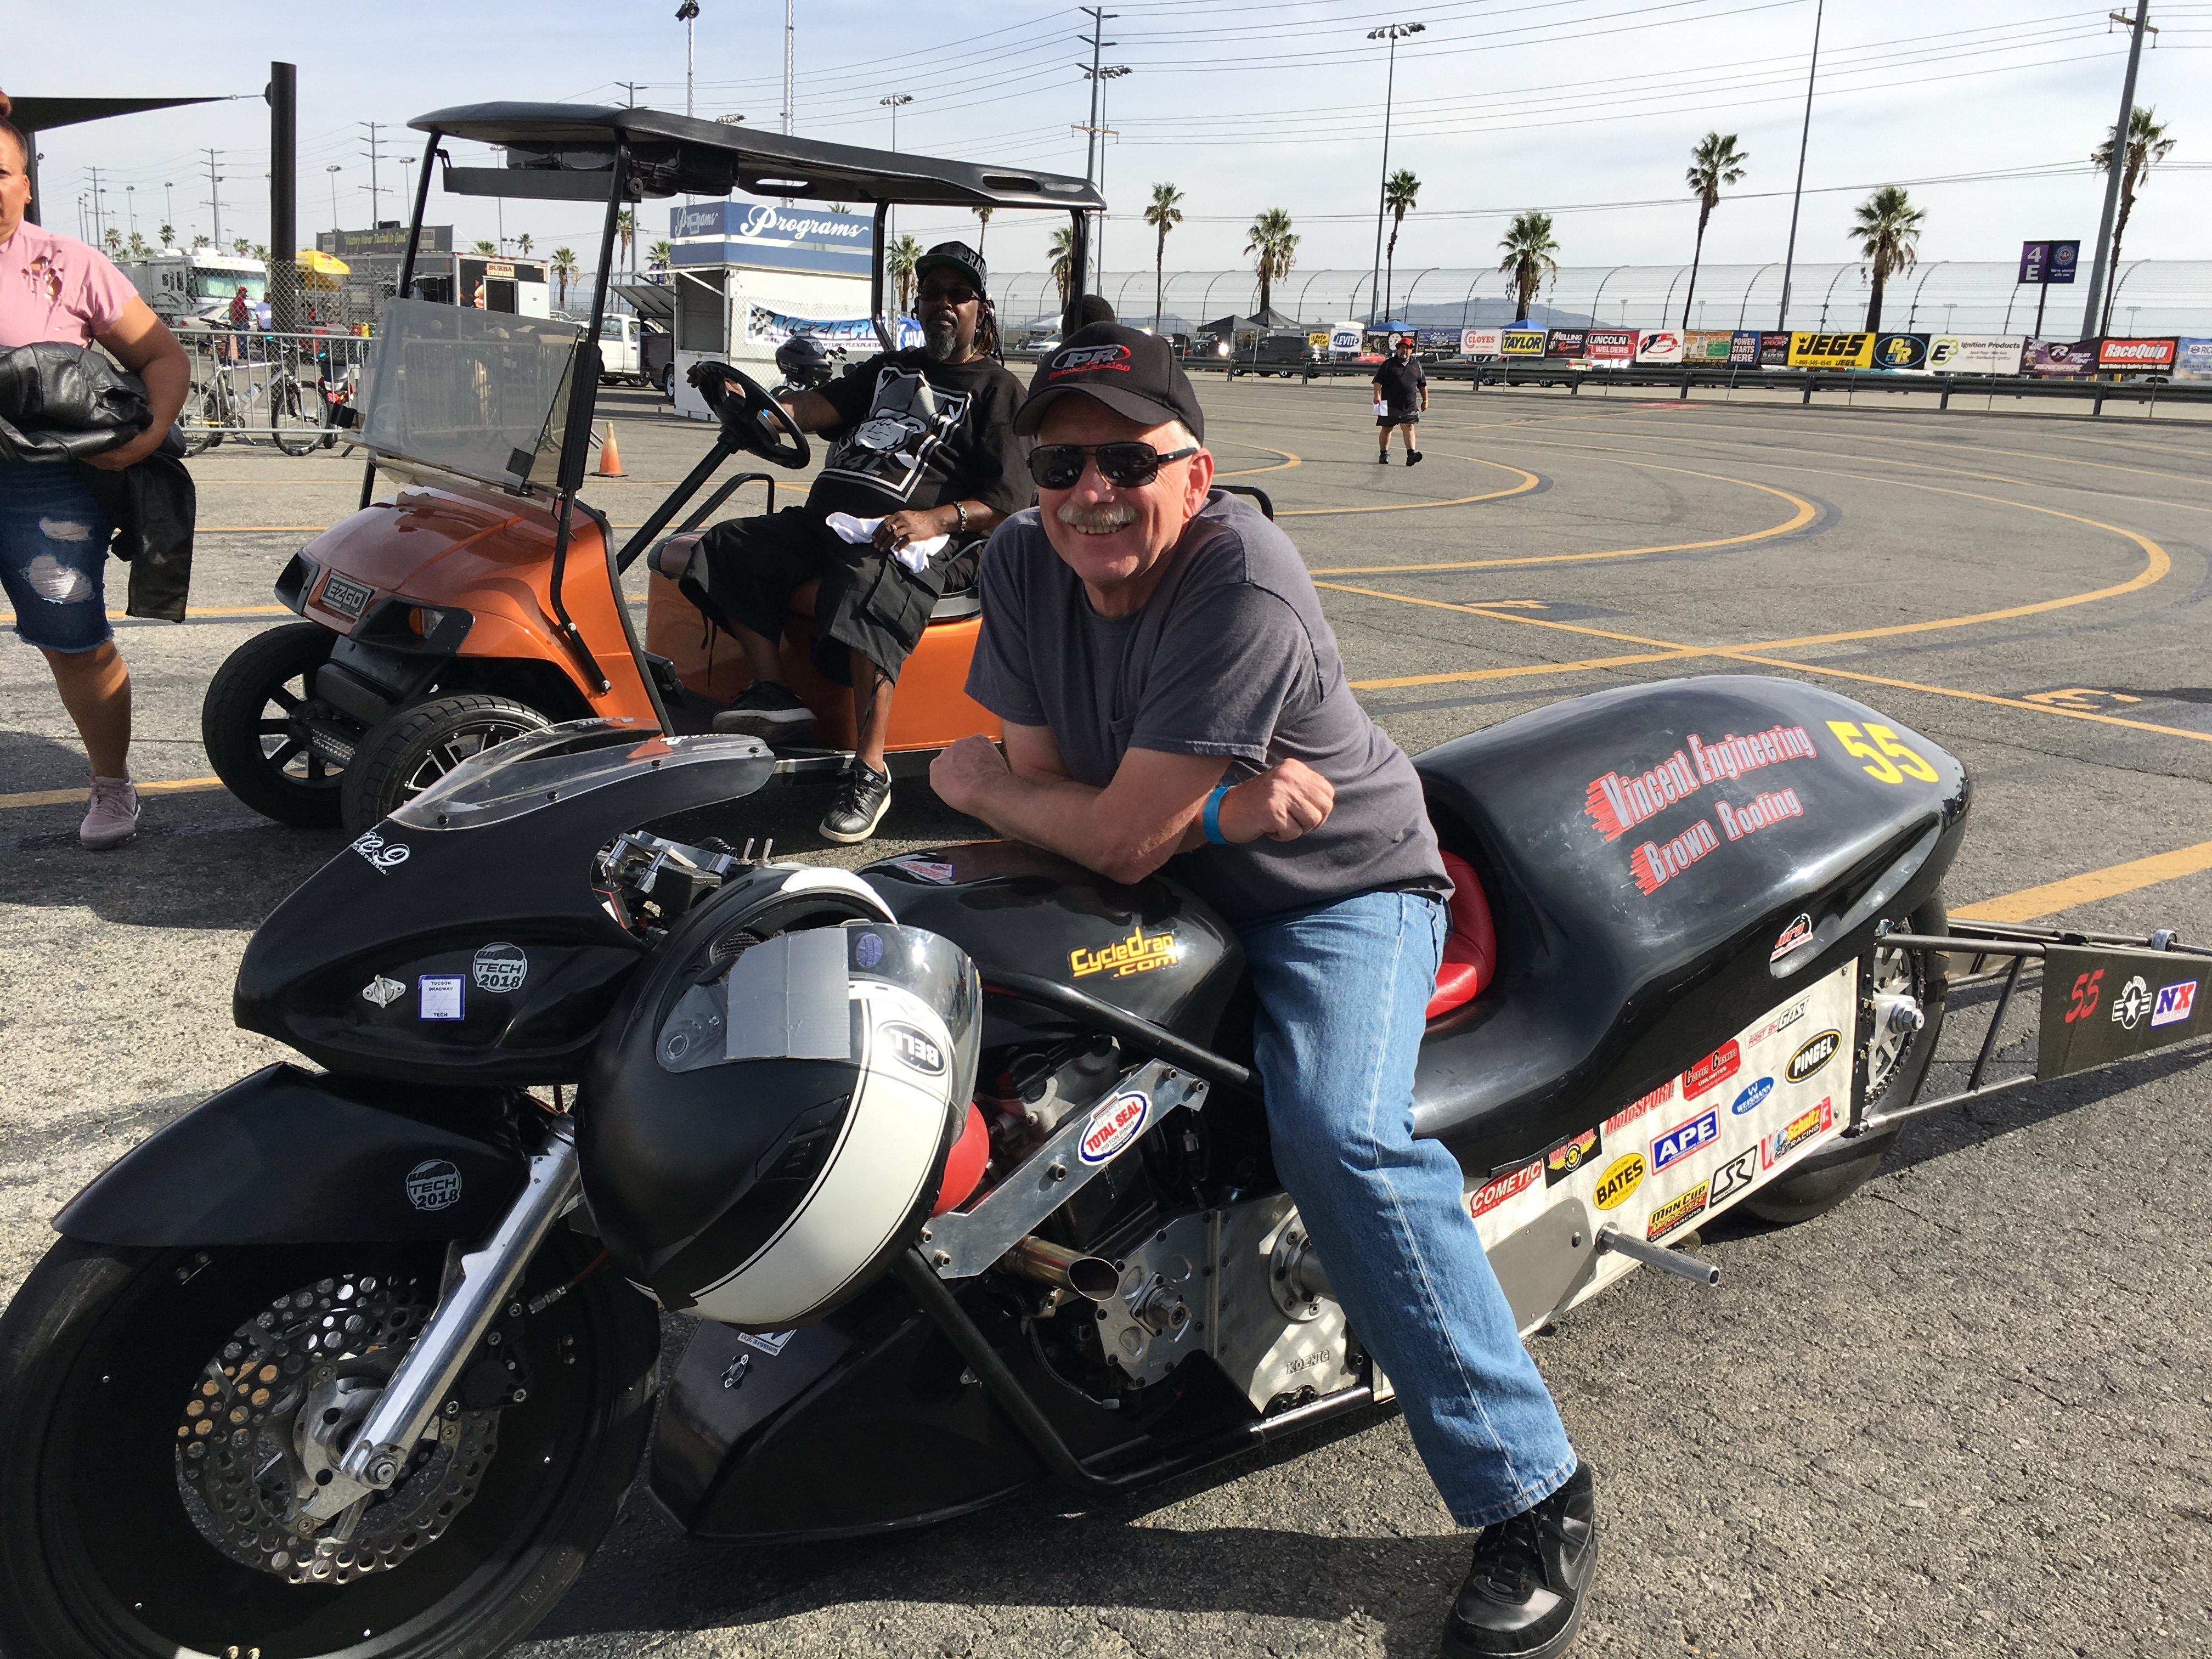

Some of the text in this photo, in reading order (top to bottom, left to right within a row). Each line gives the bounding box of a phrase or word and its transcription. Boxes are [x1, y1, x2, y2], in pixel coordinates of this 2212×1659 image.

[741, 205, 869, 240] Programs
[2027, 247, 2041, 262] 4
[2025, 264, 2040, 280] E
[771, 314, 878, 341] MEZIER
[1331, 334, 1359, 346] CLEVITE
[1552, 331, 1583, 341] MELLING
[1590, 336, 1627, 345] LINCOLN
[1503, 336, 1543, 349] TAYLOR
[1595, 346, 1629, 354] WELDERS
[1796, 334, 1868, 356] JEGS
[2104, 343, 2168, 359] RaceQuip
[1730, 353, 1753, 362] HERE
[328, 582, 364, 608] EZGO
[1825, 720, 1940, 784] 55
[1599, 725, 1817, 831] Vincent Engineering
[1643, 787, 1805, 885] Brown Roofing
[476, 962, 522, 974] TECH
[1113, 955, 1177, 978] .com
[478, 974, 521, 988] 2018
[2064, 969, 2104, 1024] 55
[2156, 983, 2195, 1015] NX
[889, 1028, 939, 1069] BELL
[1794, 1036, 1833, 1076] PINGEL
[1698, 1066, 1727, 1086] UNLIMITED
[1737, 1084, 1770, 1113] WEISMANN
[1086, 1101, 1141, 1152] TOTAL SEAL
[1101, 1120, 1135, 1152] PISTON RINGS
[1788, 1109, 1820, 1141] Schnitz
[1791, 1124, 1819, 1147] RACING
[1658, 1116, 1714, 1163] APE
[1606, 1159, 1629, 1178] CUSTOM
[409, 1177, 456, 1194] TECH
[1472, 1160, 1541, 1211] COMETIC
[1596, 1158, 1643, 1206] BATES
[1607, 1182, 1637, 1207] LEATHERS
[417, 1189, 458, 1207] 2018
[1652, 1200, 1681, 1224] MAN
[1683, 1184, 1706, 1205] CUP
[1651, 1207, 1701, 1241] DRAG RACING
[1286, 1349, 1330, 1375] KOENIG
